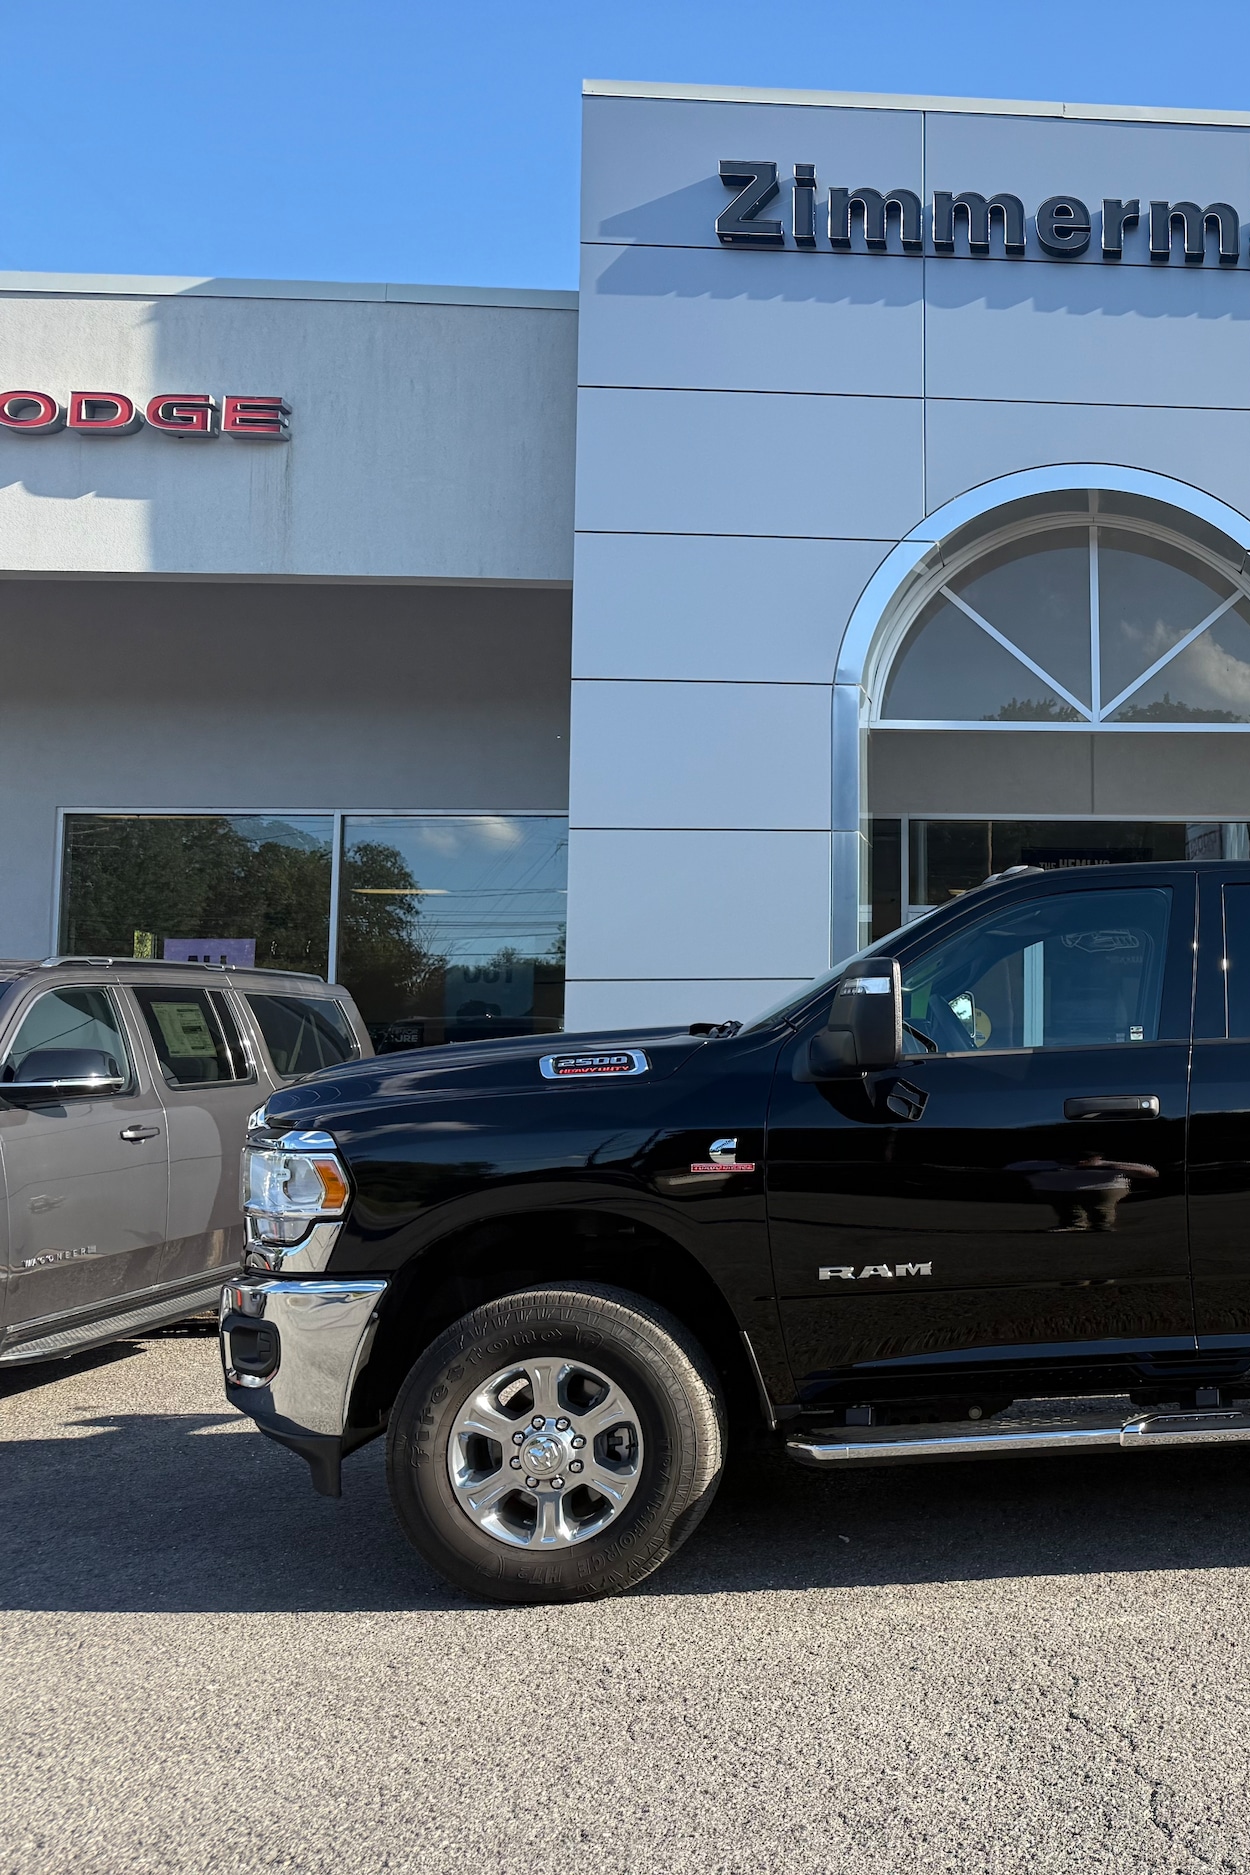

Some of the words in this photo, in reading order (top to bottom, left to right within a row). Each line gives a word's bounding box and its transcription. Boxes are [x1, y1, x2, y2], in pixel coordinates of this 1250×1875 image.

[0, 390, 292, 441] ODGE
[557, 1056, 629, 1067] 2500
[818, 1261, 933, 1281] RAM
[409, 1327, 564, 1469] Firestone
